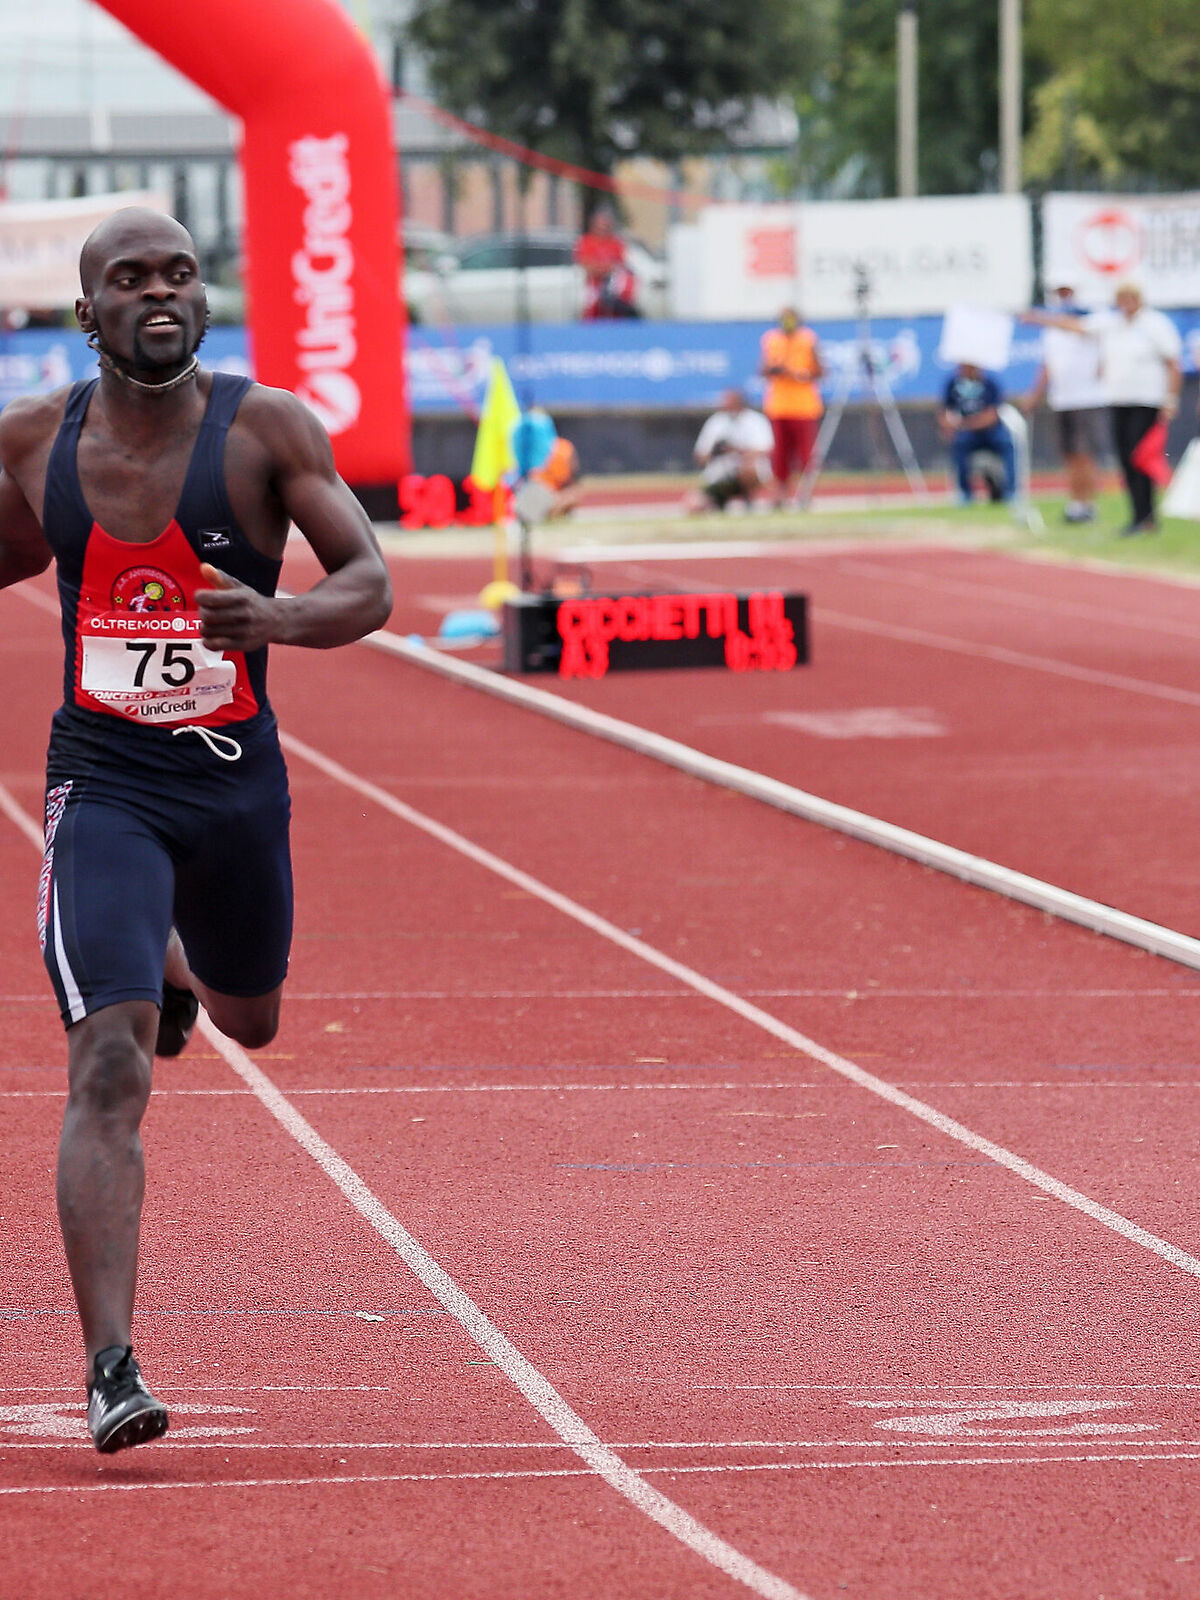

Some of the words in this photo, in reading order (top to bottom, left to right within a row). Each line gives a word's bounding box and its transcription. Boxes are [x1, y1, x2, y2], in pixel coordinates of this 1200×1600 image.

[287, 131, 357, 369] UniCredit
[90, 617, 202, 632] OLTREMODOLT
[126, 642, 196, 688] 75
[140, 700, 197, 716] UniCredit
